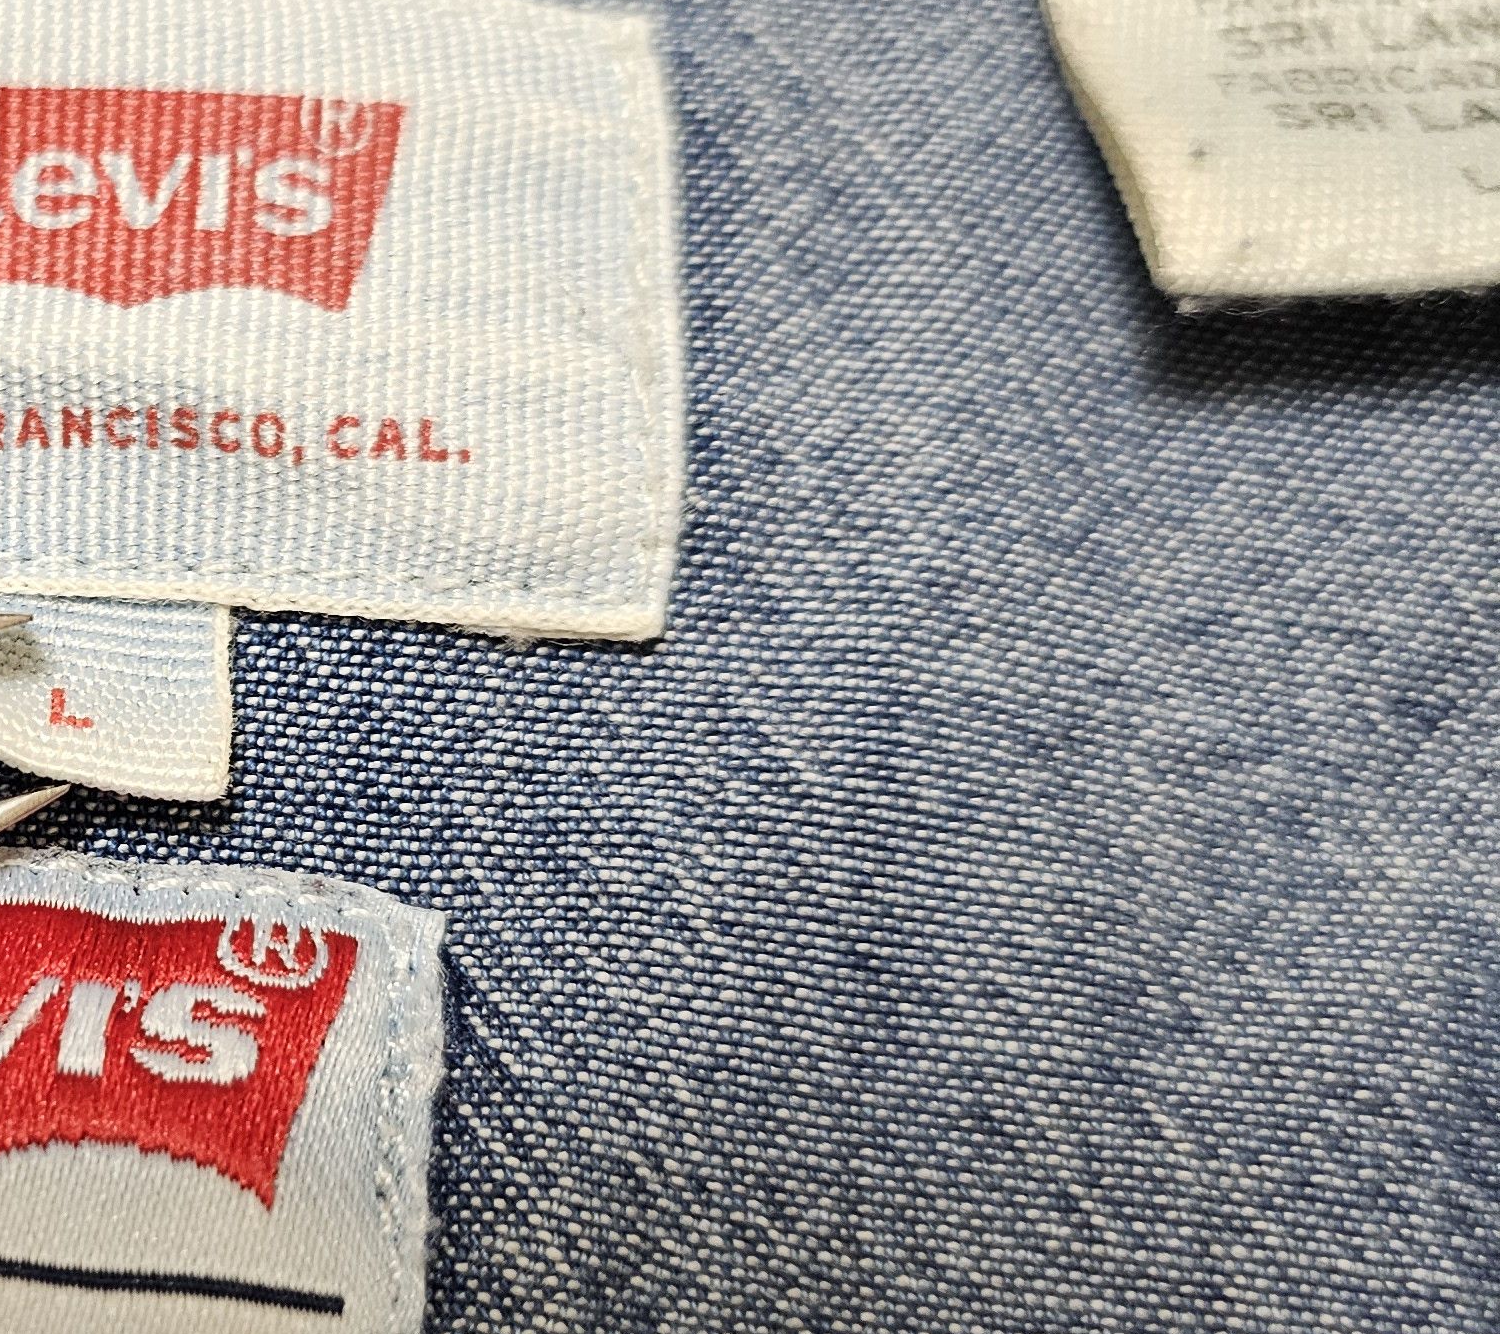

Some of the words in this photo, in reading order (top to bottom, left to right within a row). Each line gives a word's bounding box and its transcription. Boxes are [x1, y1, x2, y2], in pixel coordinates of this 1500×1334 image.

[1218, 18, 1336, 60] SRI
[325, 414, 474, 465] CAL.
[50, 687, 94, 729] L
